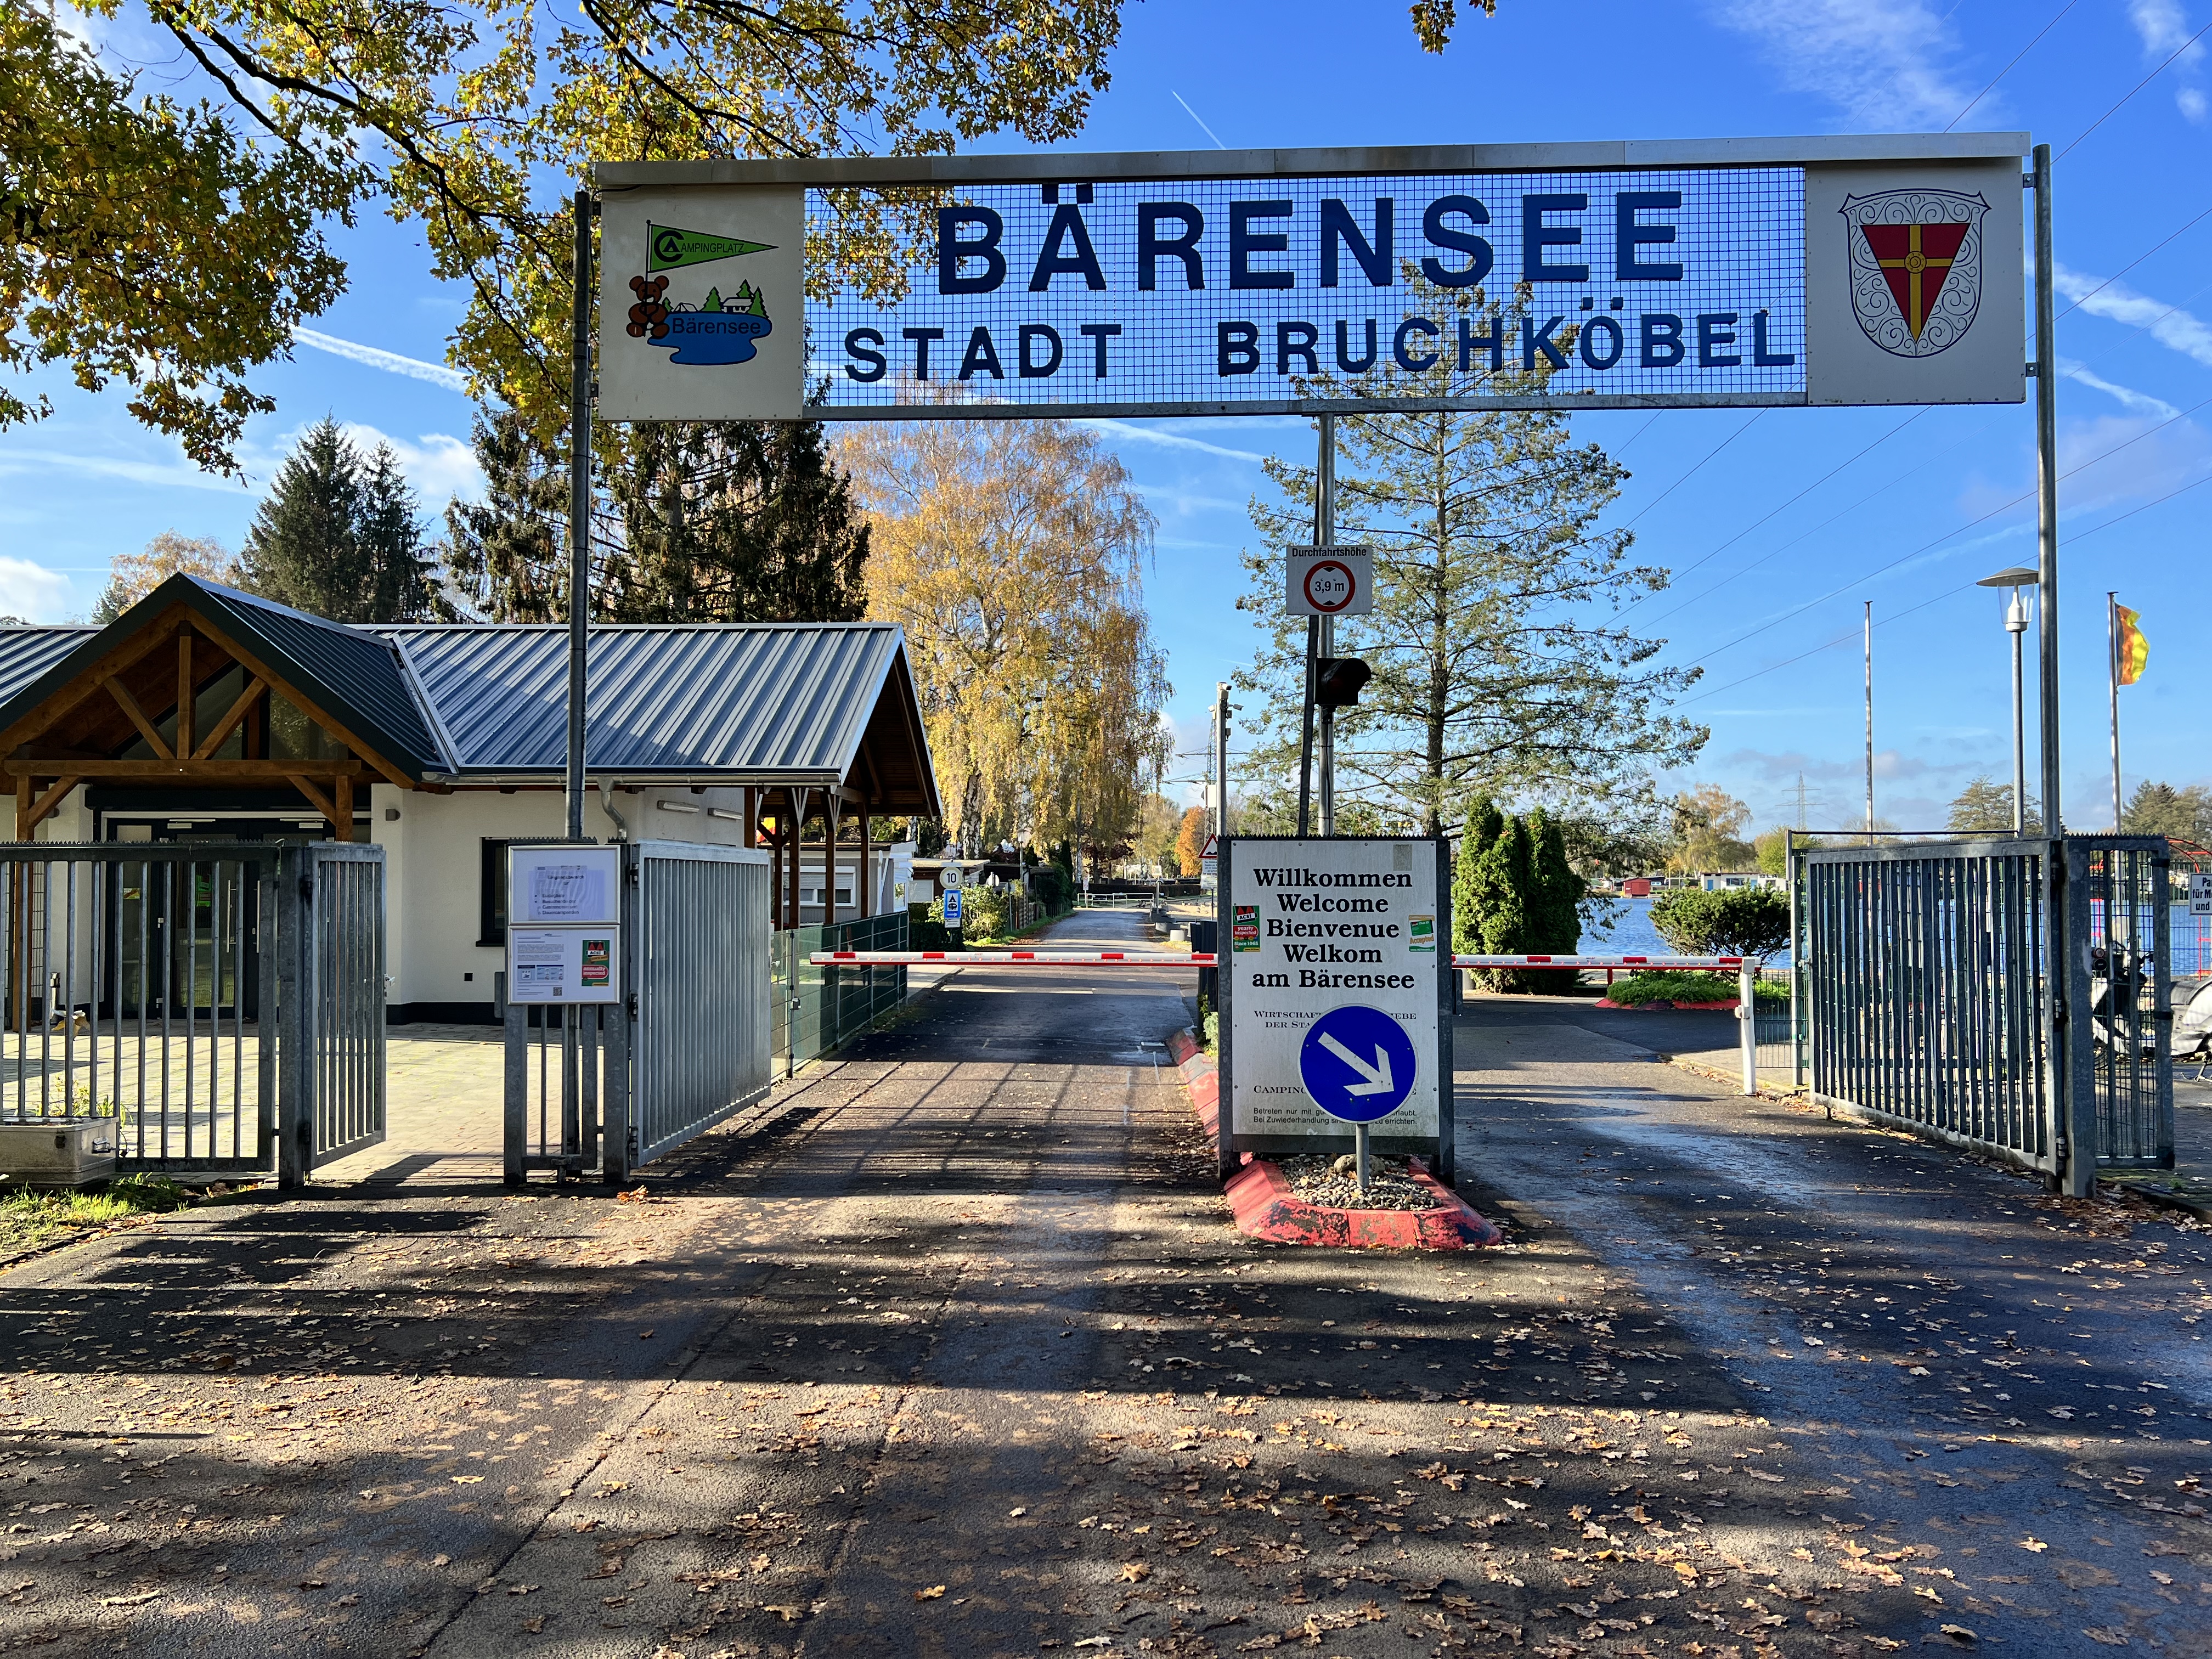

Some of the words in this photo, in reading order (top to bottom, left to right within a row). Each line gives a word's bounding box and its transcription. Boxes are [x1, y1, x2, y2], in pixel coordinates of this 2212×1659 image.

[654, 230, 744, 263] CAMPINGPLATZ
[939, 183, 1683, 295] BÄRENSEE
[672, 318, 761, 334] Bärensee
[844, 324, 1121, 382] STADT
[1218, 297, 1795, 376] BRUCHKÖBEL
[1292, 547, 1367, 557] Durchfahrtshöhe
[1314, 581, 1331, 593] 3,9
[1334, 583, 1345, 591] m
[947, 873, 956, 883] 10
[1253, 868, 1412, 887] Willkommen
[2192, 889, 2203, 898] für
[1277, 894, 1389, 912] Welcome
[2196, 901, 2210, 911] und
[1266, 918, 1400, 938] Bienvenue
[1283, 944, 1383, 963] Welkom
[1252, 973, 1290, 987] am
[1299, 969, 1414, 989] Bärensee
[1266, 1116, 1329, 1125] Zuwiederhandlung
